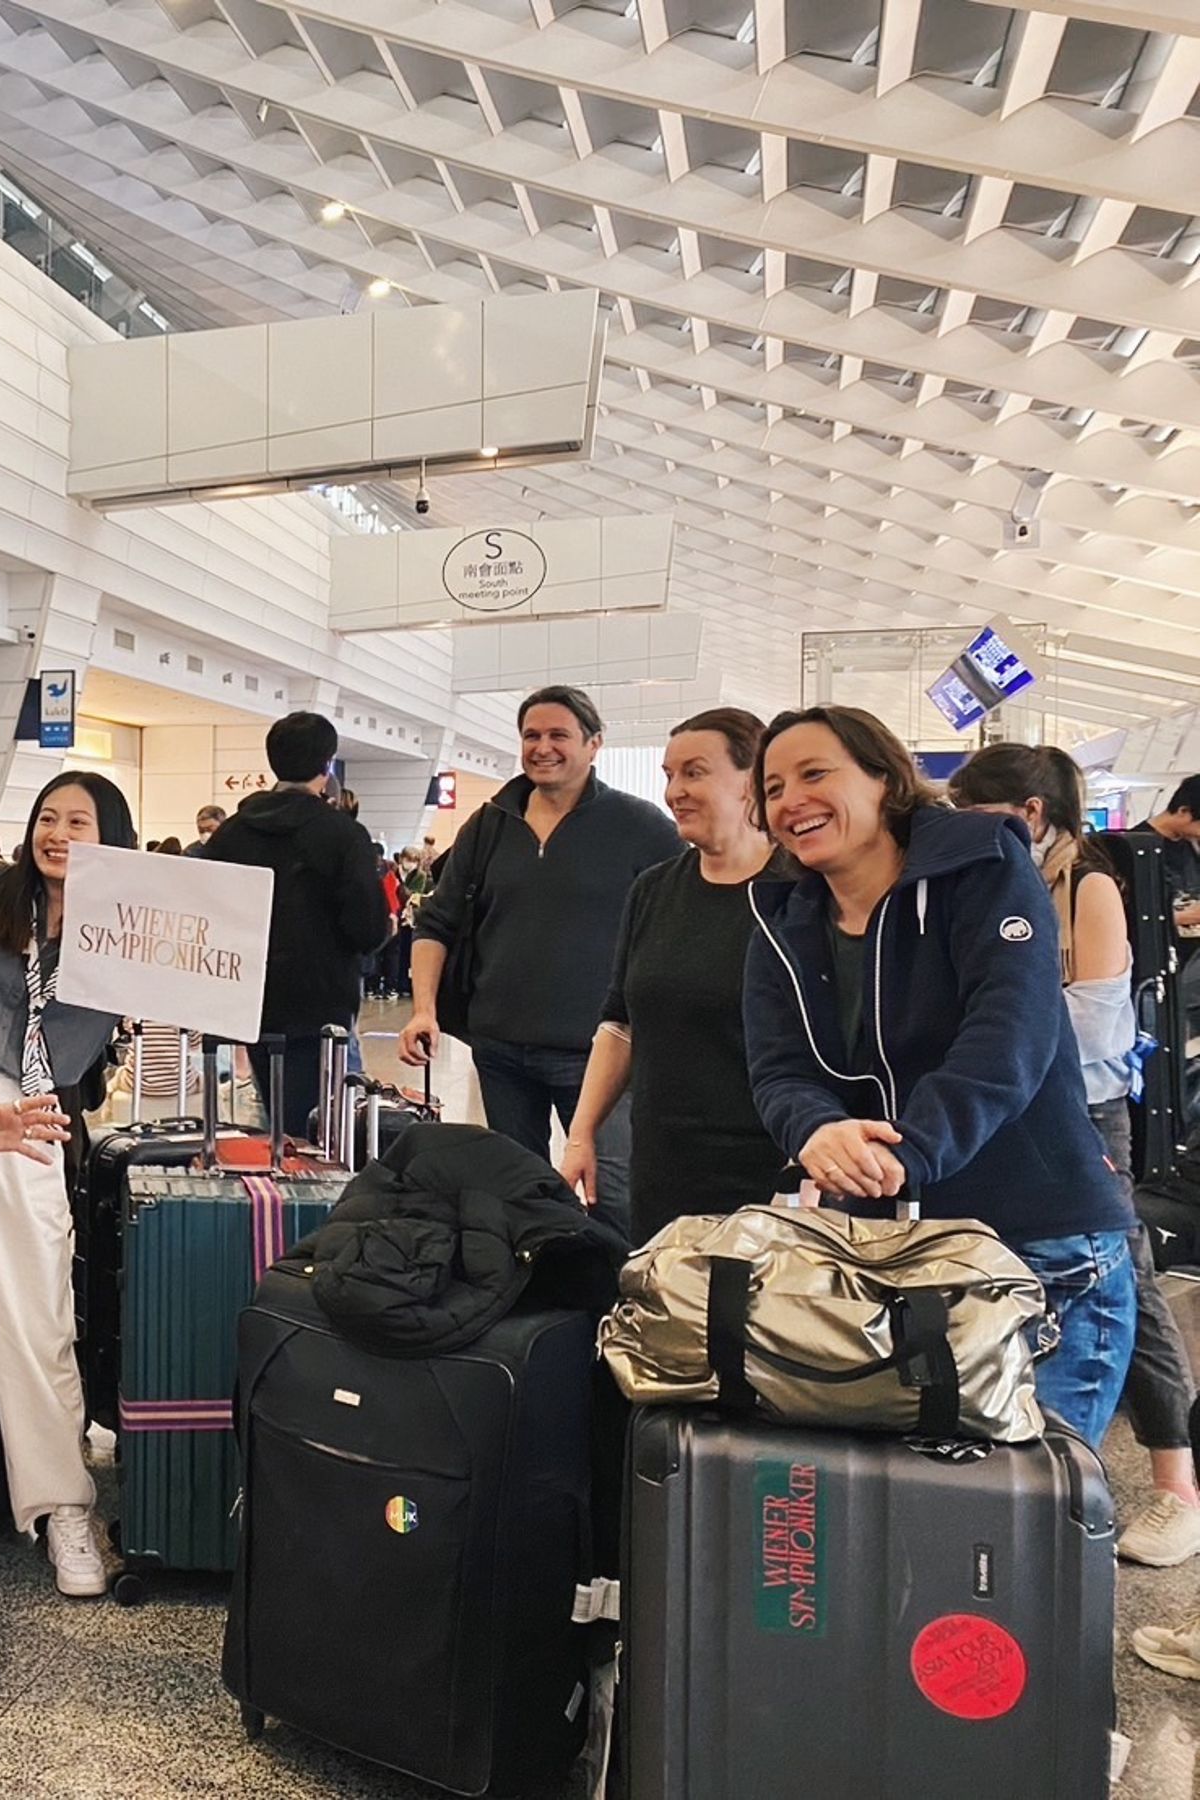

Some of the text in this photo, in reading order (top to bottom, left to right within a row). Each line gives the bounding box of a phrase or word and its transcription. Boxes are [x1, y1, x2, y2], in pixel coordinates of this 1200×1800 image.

[485, 532, 503, 560] S
[463, 561, 523, 579] 南會面點
[479, 579, 508, 588] South
[459, 587, 529, 600] meeting point
[117, 902, 209, 946] WIENER
[78, 924, 242, 982] SYMPHONIKER
[763, 1495, 789, 1587] WIENER
[789, 1463, 816, 1630] SYMPHONIKER
[952, 1633, 995, 1661] TOUR
